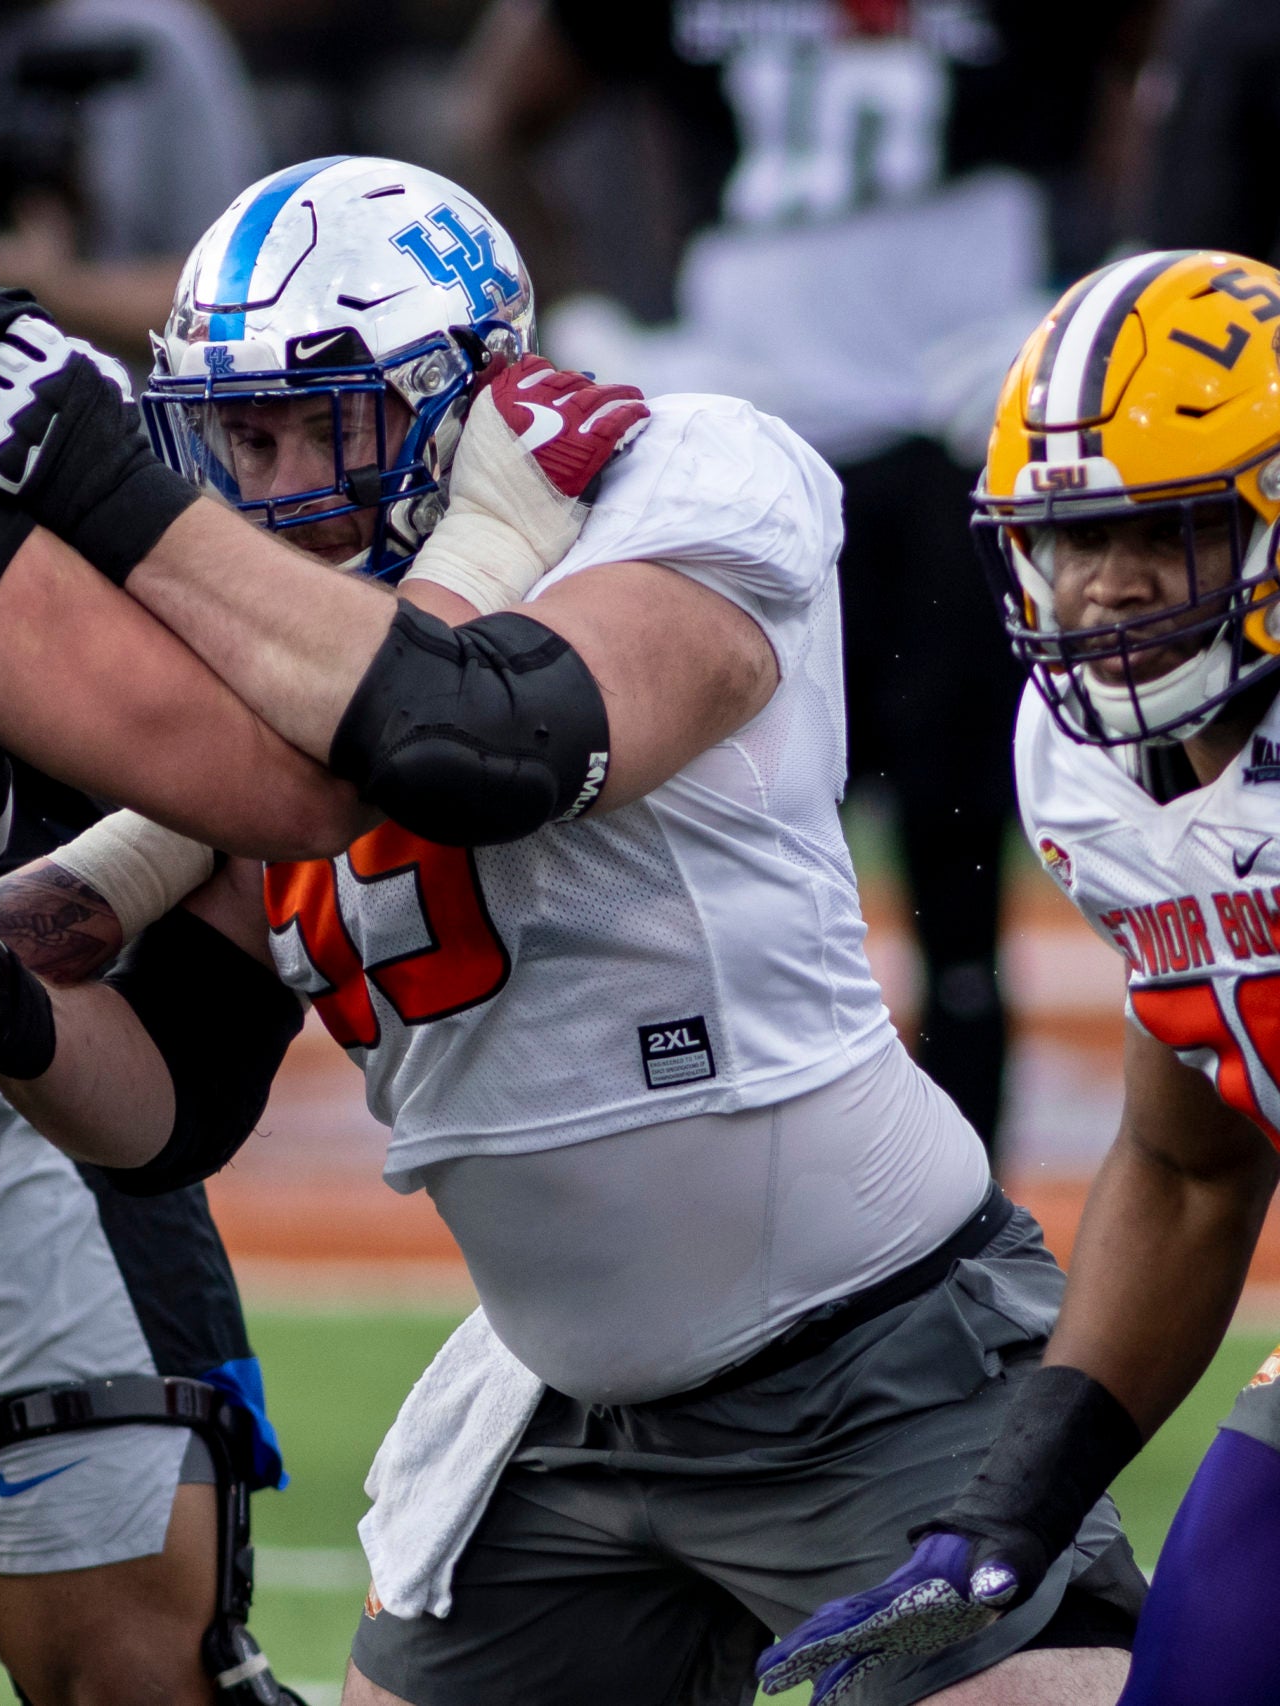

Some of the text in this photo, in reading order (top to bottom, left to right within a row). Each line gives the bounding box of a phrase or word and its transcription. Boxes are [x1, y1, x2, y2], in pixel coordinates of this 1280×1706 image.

[388, 203, 521, 323] UK
[1168, 267, 1280, 371] LS
[1030, 464, 1088, 493] LSU
[647, 1027, 700, 1053] 2XL
